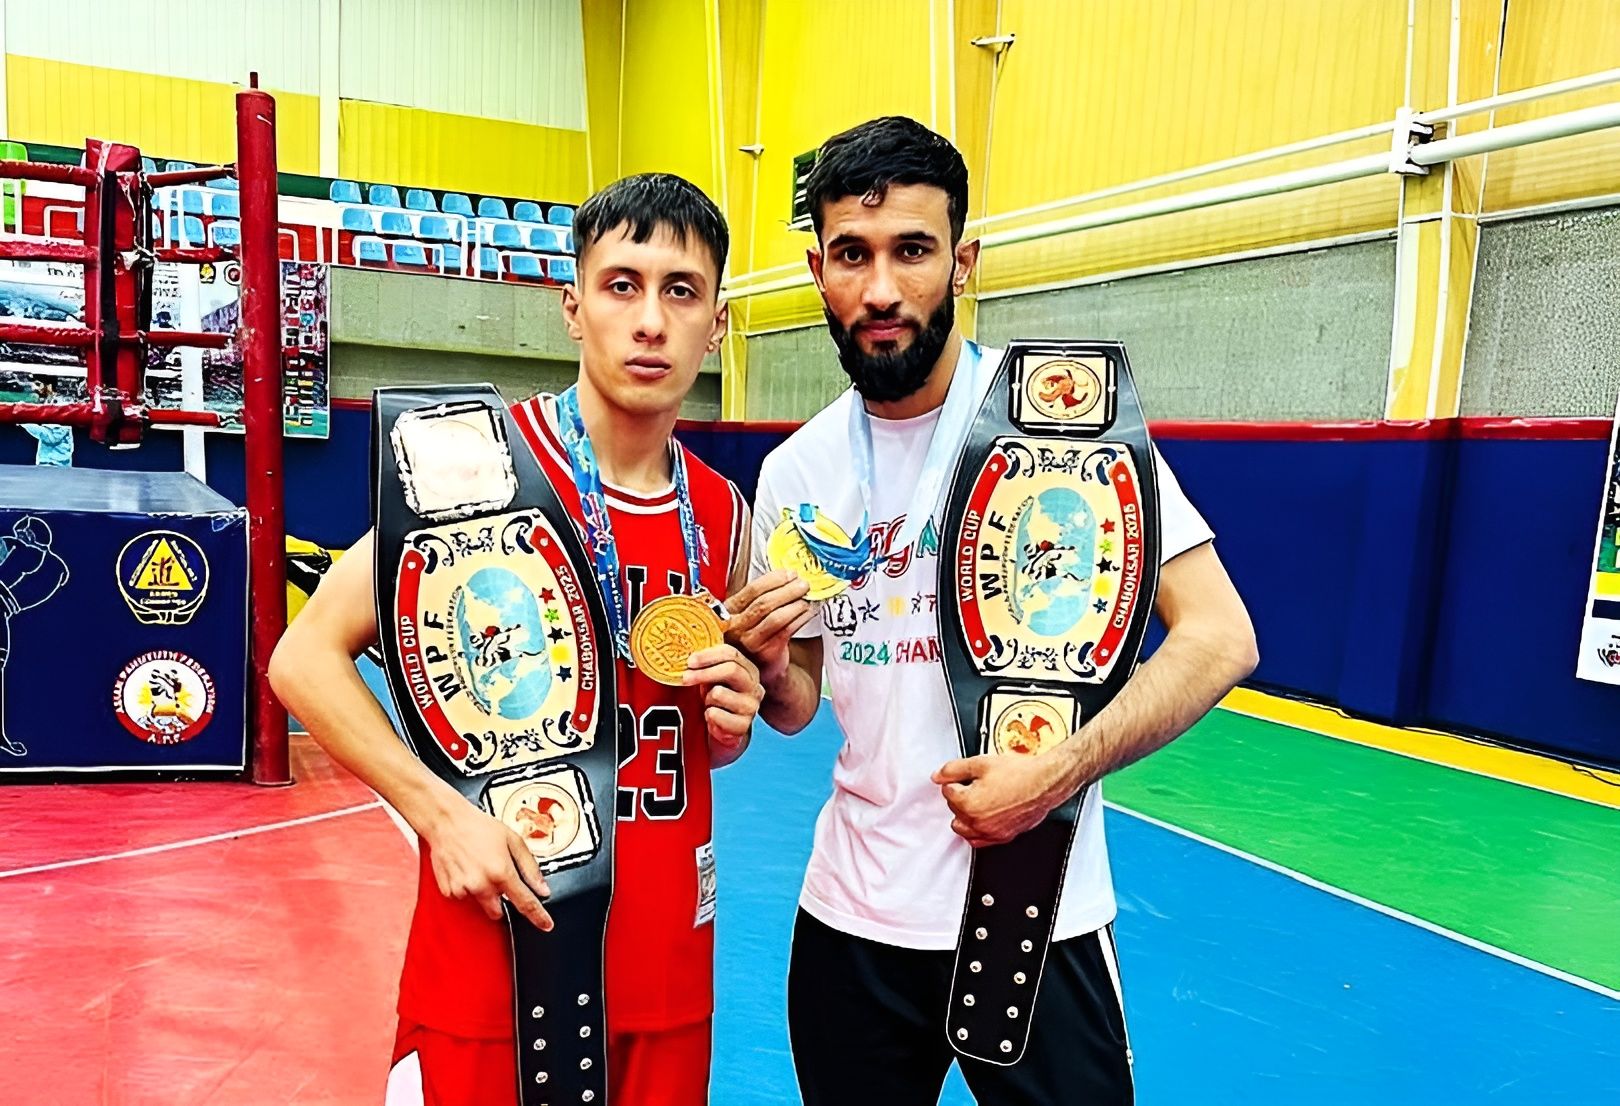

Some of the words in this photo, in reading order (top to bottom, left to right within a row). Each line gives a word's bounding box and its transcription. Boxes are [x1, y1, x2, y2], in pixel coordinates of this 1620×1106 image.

[963, 509, 981, 540] CUP
[1123, 503, 1139, 540] 2025
[555, 565, 581, 602] 2025
[960, 545, 974, 602] WORLD
[400, 615, 416, 648] CUP
[840, 640, 892, 666] 2024
[405, 653, 434, 710] WORLD
